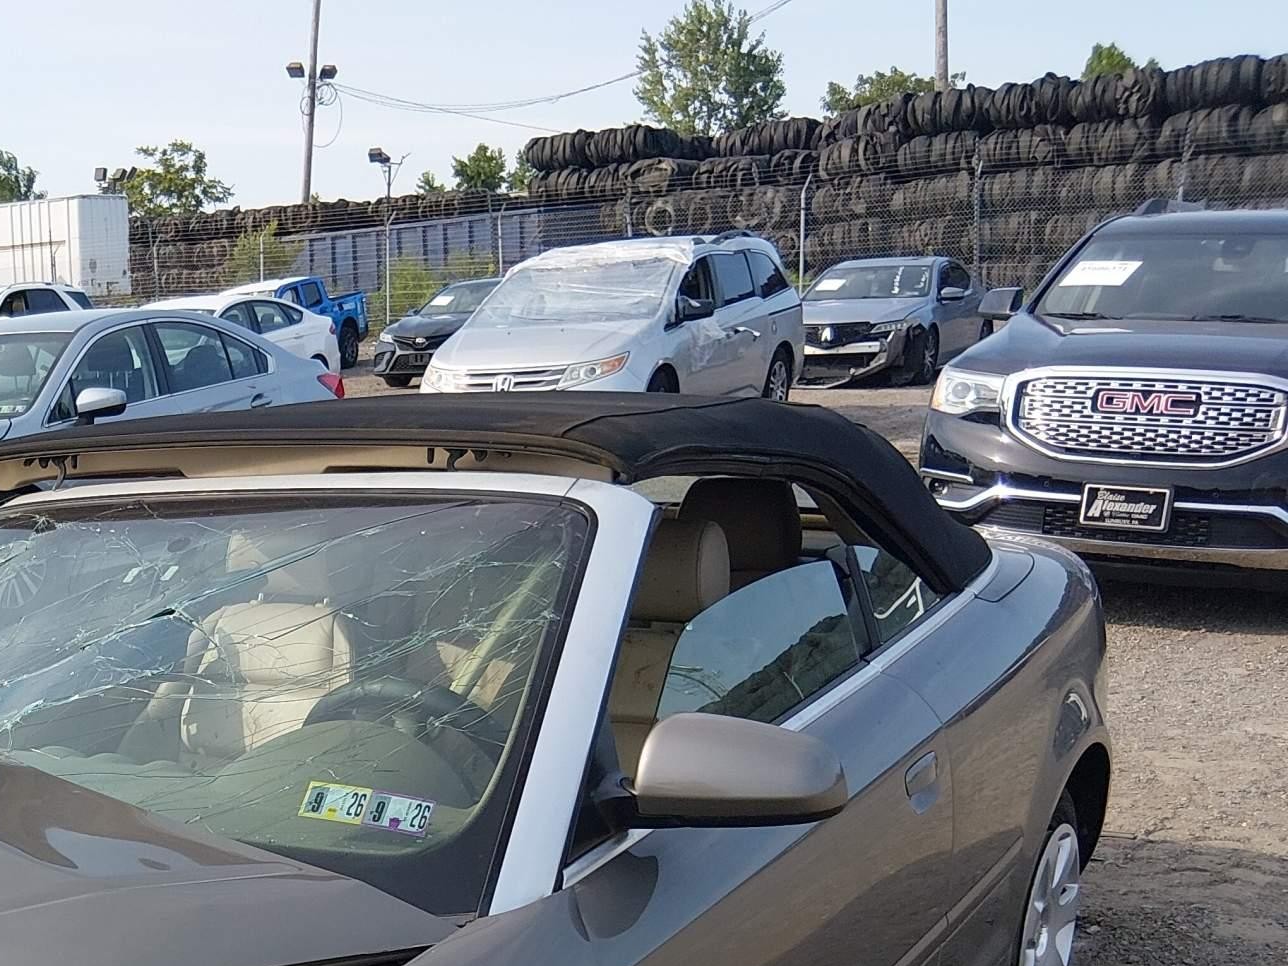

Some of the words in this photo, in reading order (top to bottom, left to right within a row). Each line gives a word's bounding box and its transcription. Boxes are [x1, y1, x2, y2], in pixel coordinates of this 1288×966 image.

[1096, 390, 1197, 416] GMC
[1086, 499, 1158, 518] Alexander
[311, 791, 325, 813] 9
[346, 792, 368, 818] 26
[371, 800, 386, 823] 9
[409, 803, 432, 830] 26
